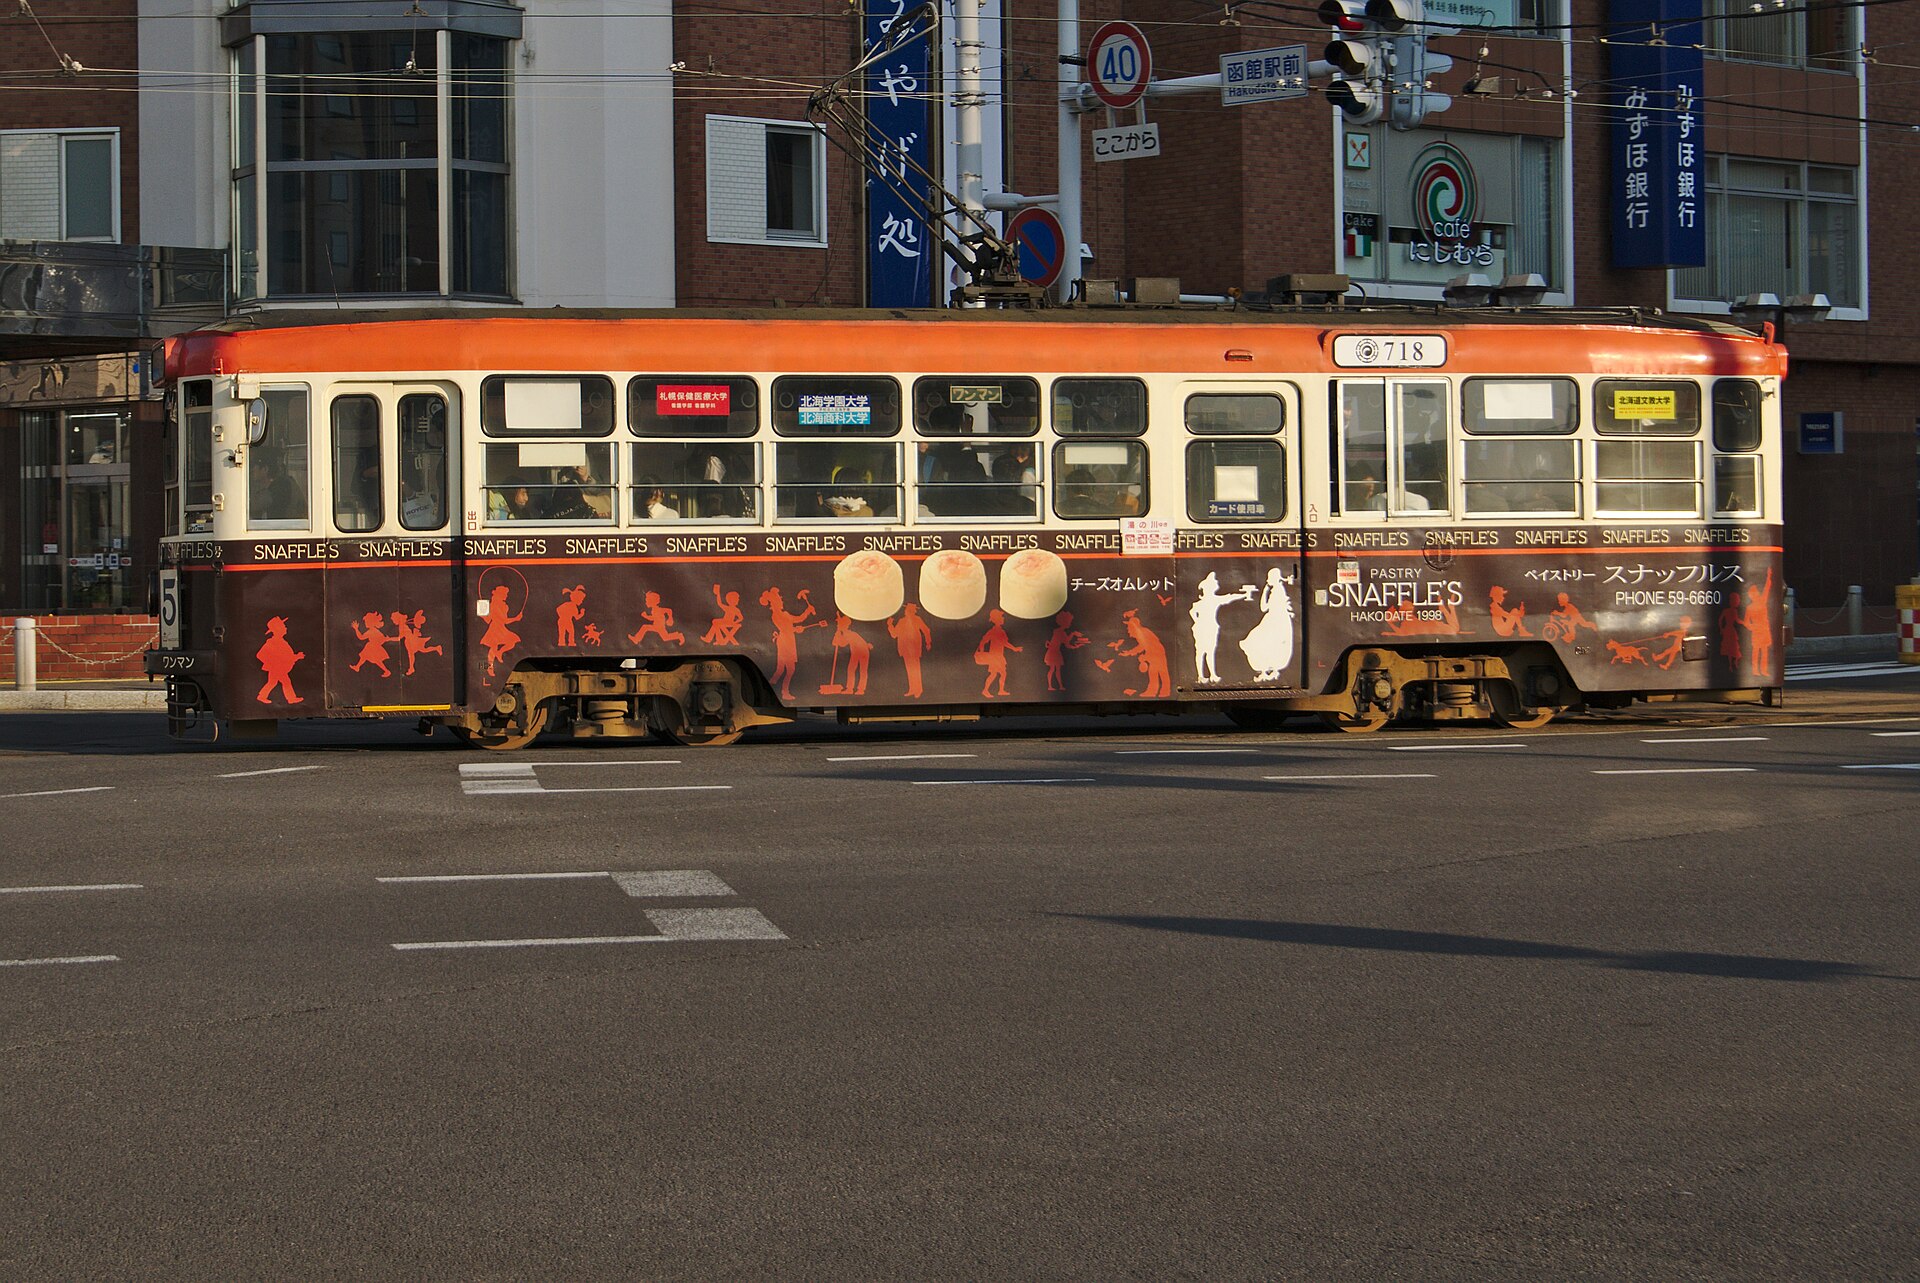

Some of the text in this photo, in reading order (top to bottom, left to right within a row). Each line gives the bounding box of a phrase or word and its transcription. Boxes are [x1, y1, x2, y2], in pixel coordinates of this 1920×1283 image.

[1103, 45, 1136, 83] 40
[1227, 54, 1300, 83] 函館駅前
[1095, 131, 1157, 156] ここから
[1625, 86, 1649, 229] みずほ銀行
[1345, 213, 1374, 226] Cake
[1433, 217, 1470, 238] café
[1409, 241, 1494, 266] にしむら
[1384, 342, 1424, 361] 718
[800, 395, 869, 407] 北海学園大学
[953, 388, 1000, 400] ワンマン
[468, 511, 477, 531] 出口
[1309, 503, 1318, 523] 入口
[765, 535, 846, 552] SNAFFLE'S
[863, 534, 942, 551] SNAFFLE'S
[960, 533, 1038, 550] SNAFFLE'S
[1055, 533, 1120, 550] SNAFFLE
[1334, 531, 1409, 547] SNAFFLE'S
[1426, 530, 1498, 546] SNAFFLE'S
[1515, 529, 1588, 545] SNAFFLE'S
[1603, 528, 1670, 544] SNAFFLE'S
[1684, 527, 1750, 544] SNAFFLE'S
[254, 541, 339, 560] SNAFFLE'S
[359, 540, 443, 558] SNAFFLE'S
[464, 538, 547, 555] SNAFFLE'S
[565, 537, 648, 554] SNAFFLE'S
[666, 536, 747, 553] SNAFFLE'S
[1370, 568, 1422, 579] PASTRY
[1602, 563, 1745, 585] スナッフルス
[1070, 576, 1175, 592] チーズオムレット
[1328, 579, 1463, 608] SNAFFLE'S
[1616, 590, 1721, 606] PHONE 59-6660
[162, 578, 177, 627] 5
[1350, 610, 1442, 622] HAKODATE 1998
[162, 656, 195, 669] ワンマン
